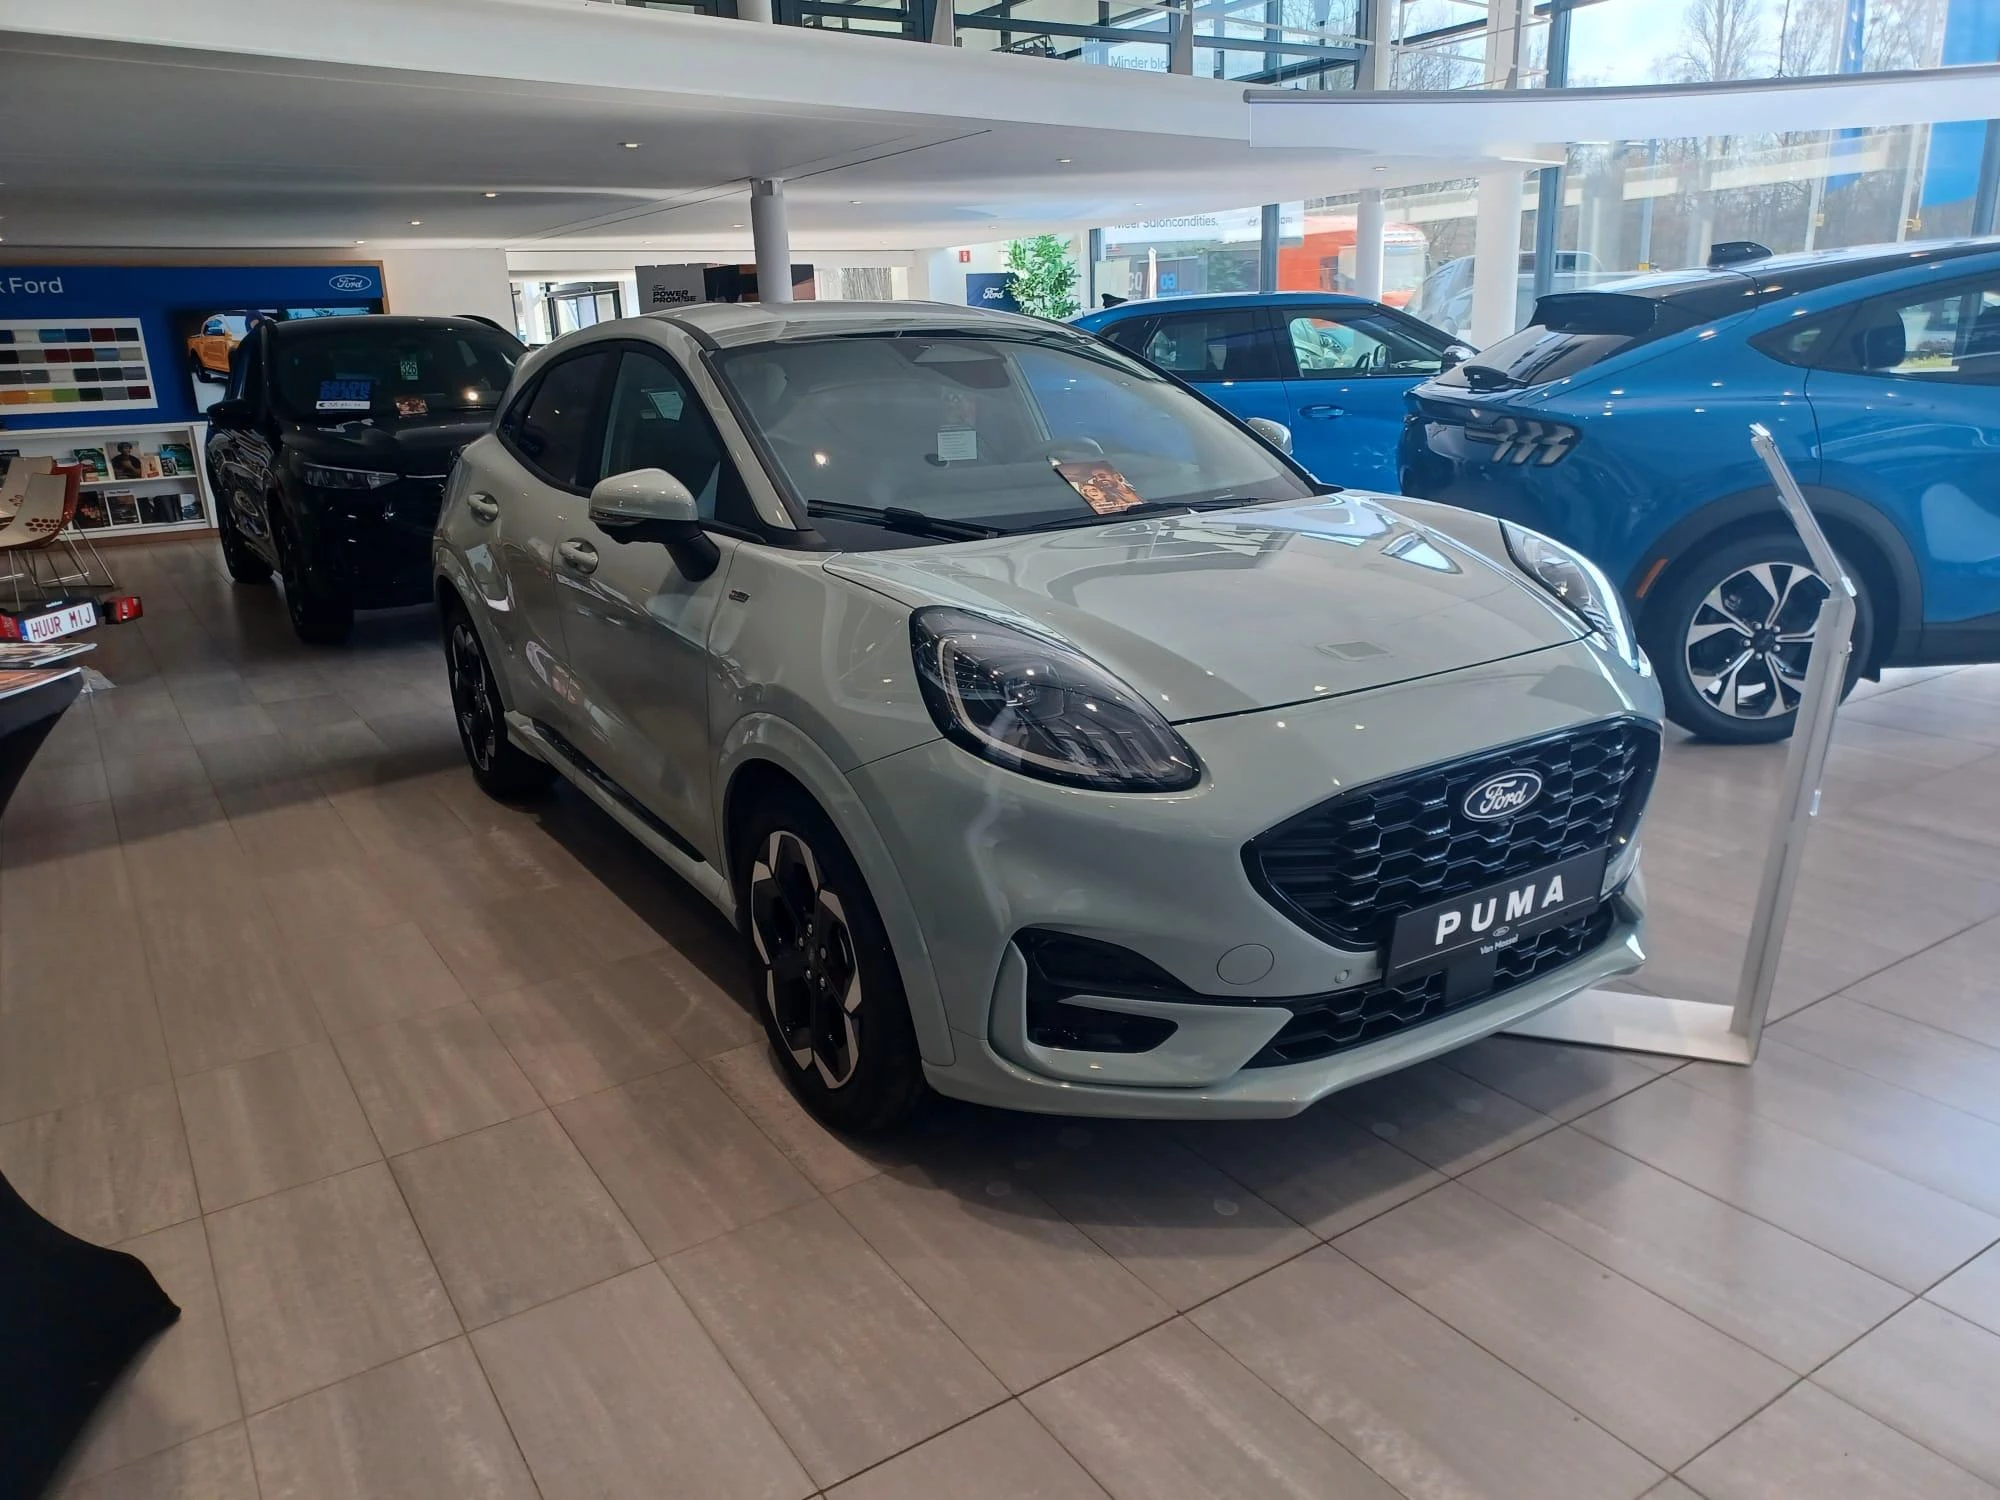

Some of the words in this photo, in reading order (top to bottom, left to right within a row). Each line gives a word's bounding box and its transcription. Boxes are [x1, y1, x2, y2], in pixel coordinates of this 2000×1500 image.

[1111, 55, 1148, 69] Minder
[9, 276, 64, 294] Ford
[336, 276, 364, 288] Ford
[652, 289, 689, 298] POWER
[983, 287, 1004, 299] Ford
[652, 295, 697, 304] PROMISE
[320, 381, 371, 390] SALON
[319, 390, 369, 400] DEALS
[30, 616, 63, 641] HUUR
[69, 607, 92, 629] MIJ
[1480, 780, 1529, 814] Ford
[1435, 875, 1565, 946] PUMA
